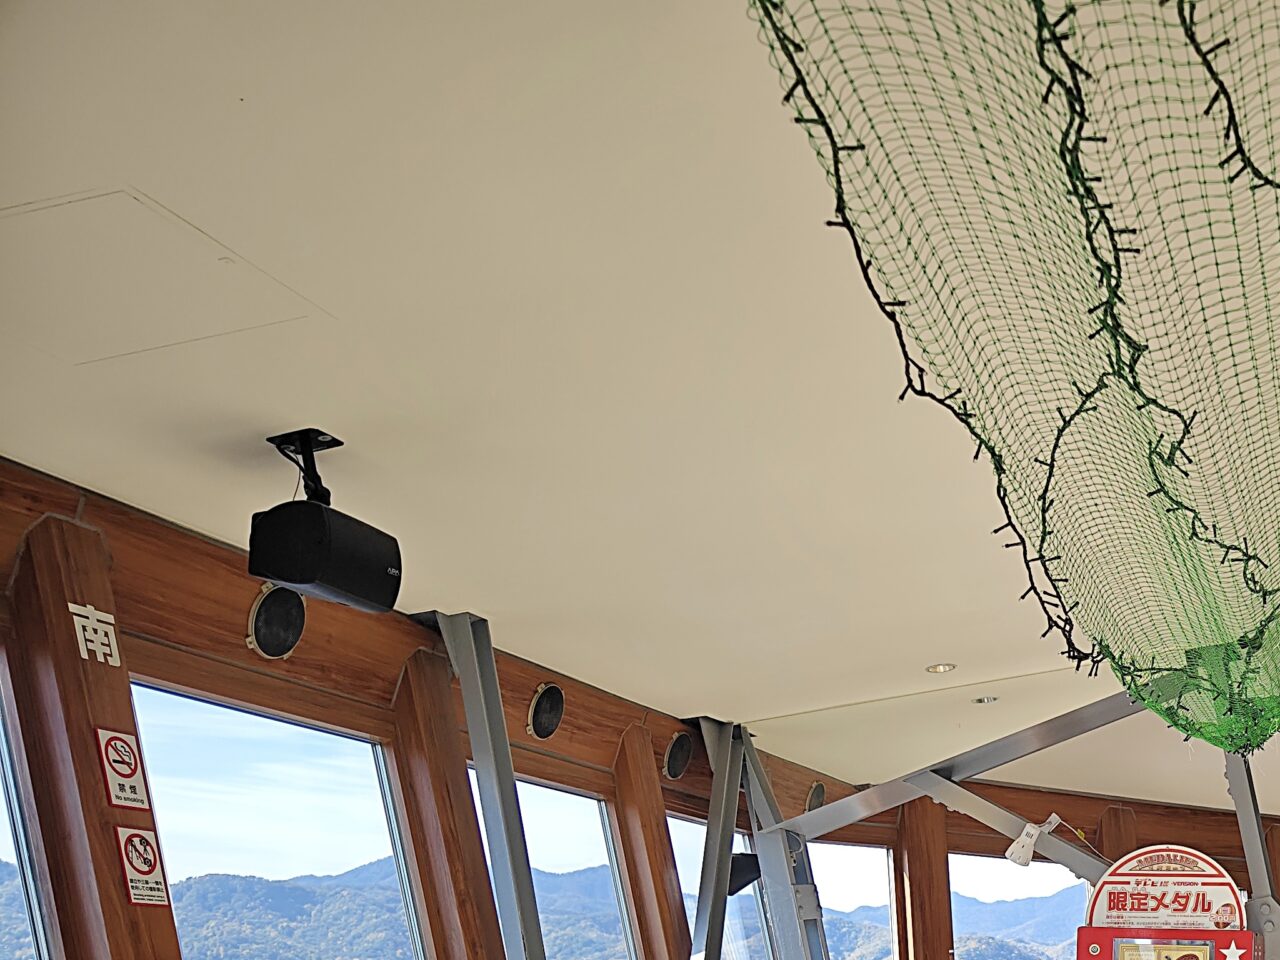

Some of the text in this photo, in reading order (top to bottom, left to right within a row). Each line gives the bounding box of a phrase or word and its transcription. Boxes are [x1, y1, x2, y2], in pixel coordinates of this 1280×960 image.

[68, 602, 121, 667] 南
[118, 783, 138, 795] 禁煙
[123, 796, 145, 805] smoking
[1107, 891, 1212, 913] 限定メダル
